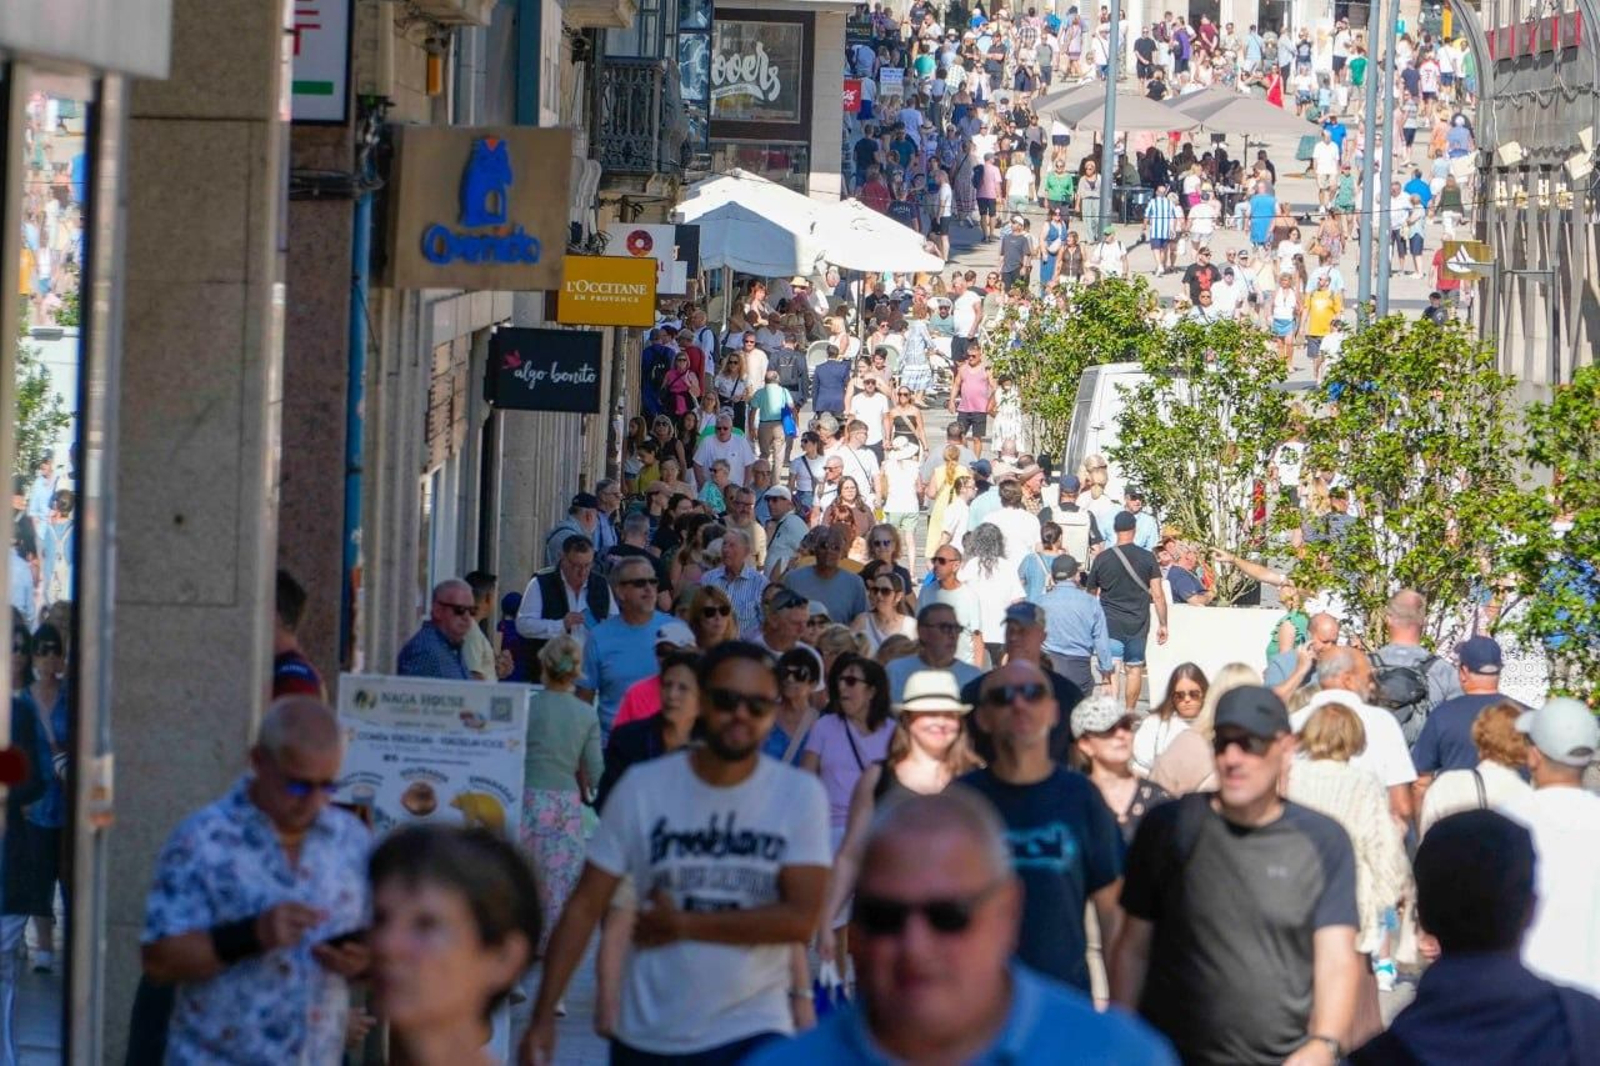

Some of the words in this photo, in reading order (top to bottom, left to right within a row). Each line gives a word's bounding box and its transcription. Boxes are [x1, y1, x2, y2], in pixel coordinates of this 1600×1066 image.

[590, 295, 639, 303] PROVENCE
[514, 361, 549, 389] algo
[550, 362, 596, 383] bonito
[381, 691, 417, 704] NAGA
